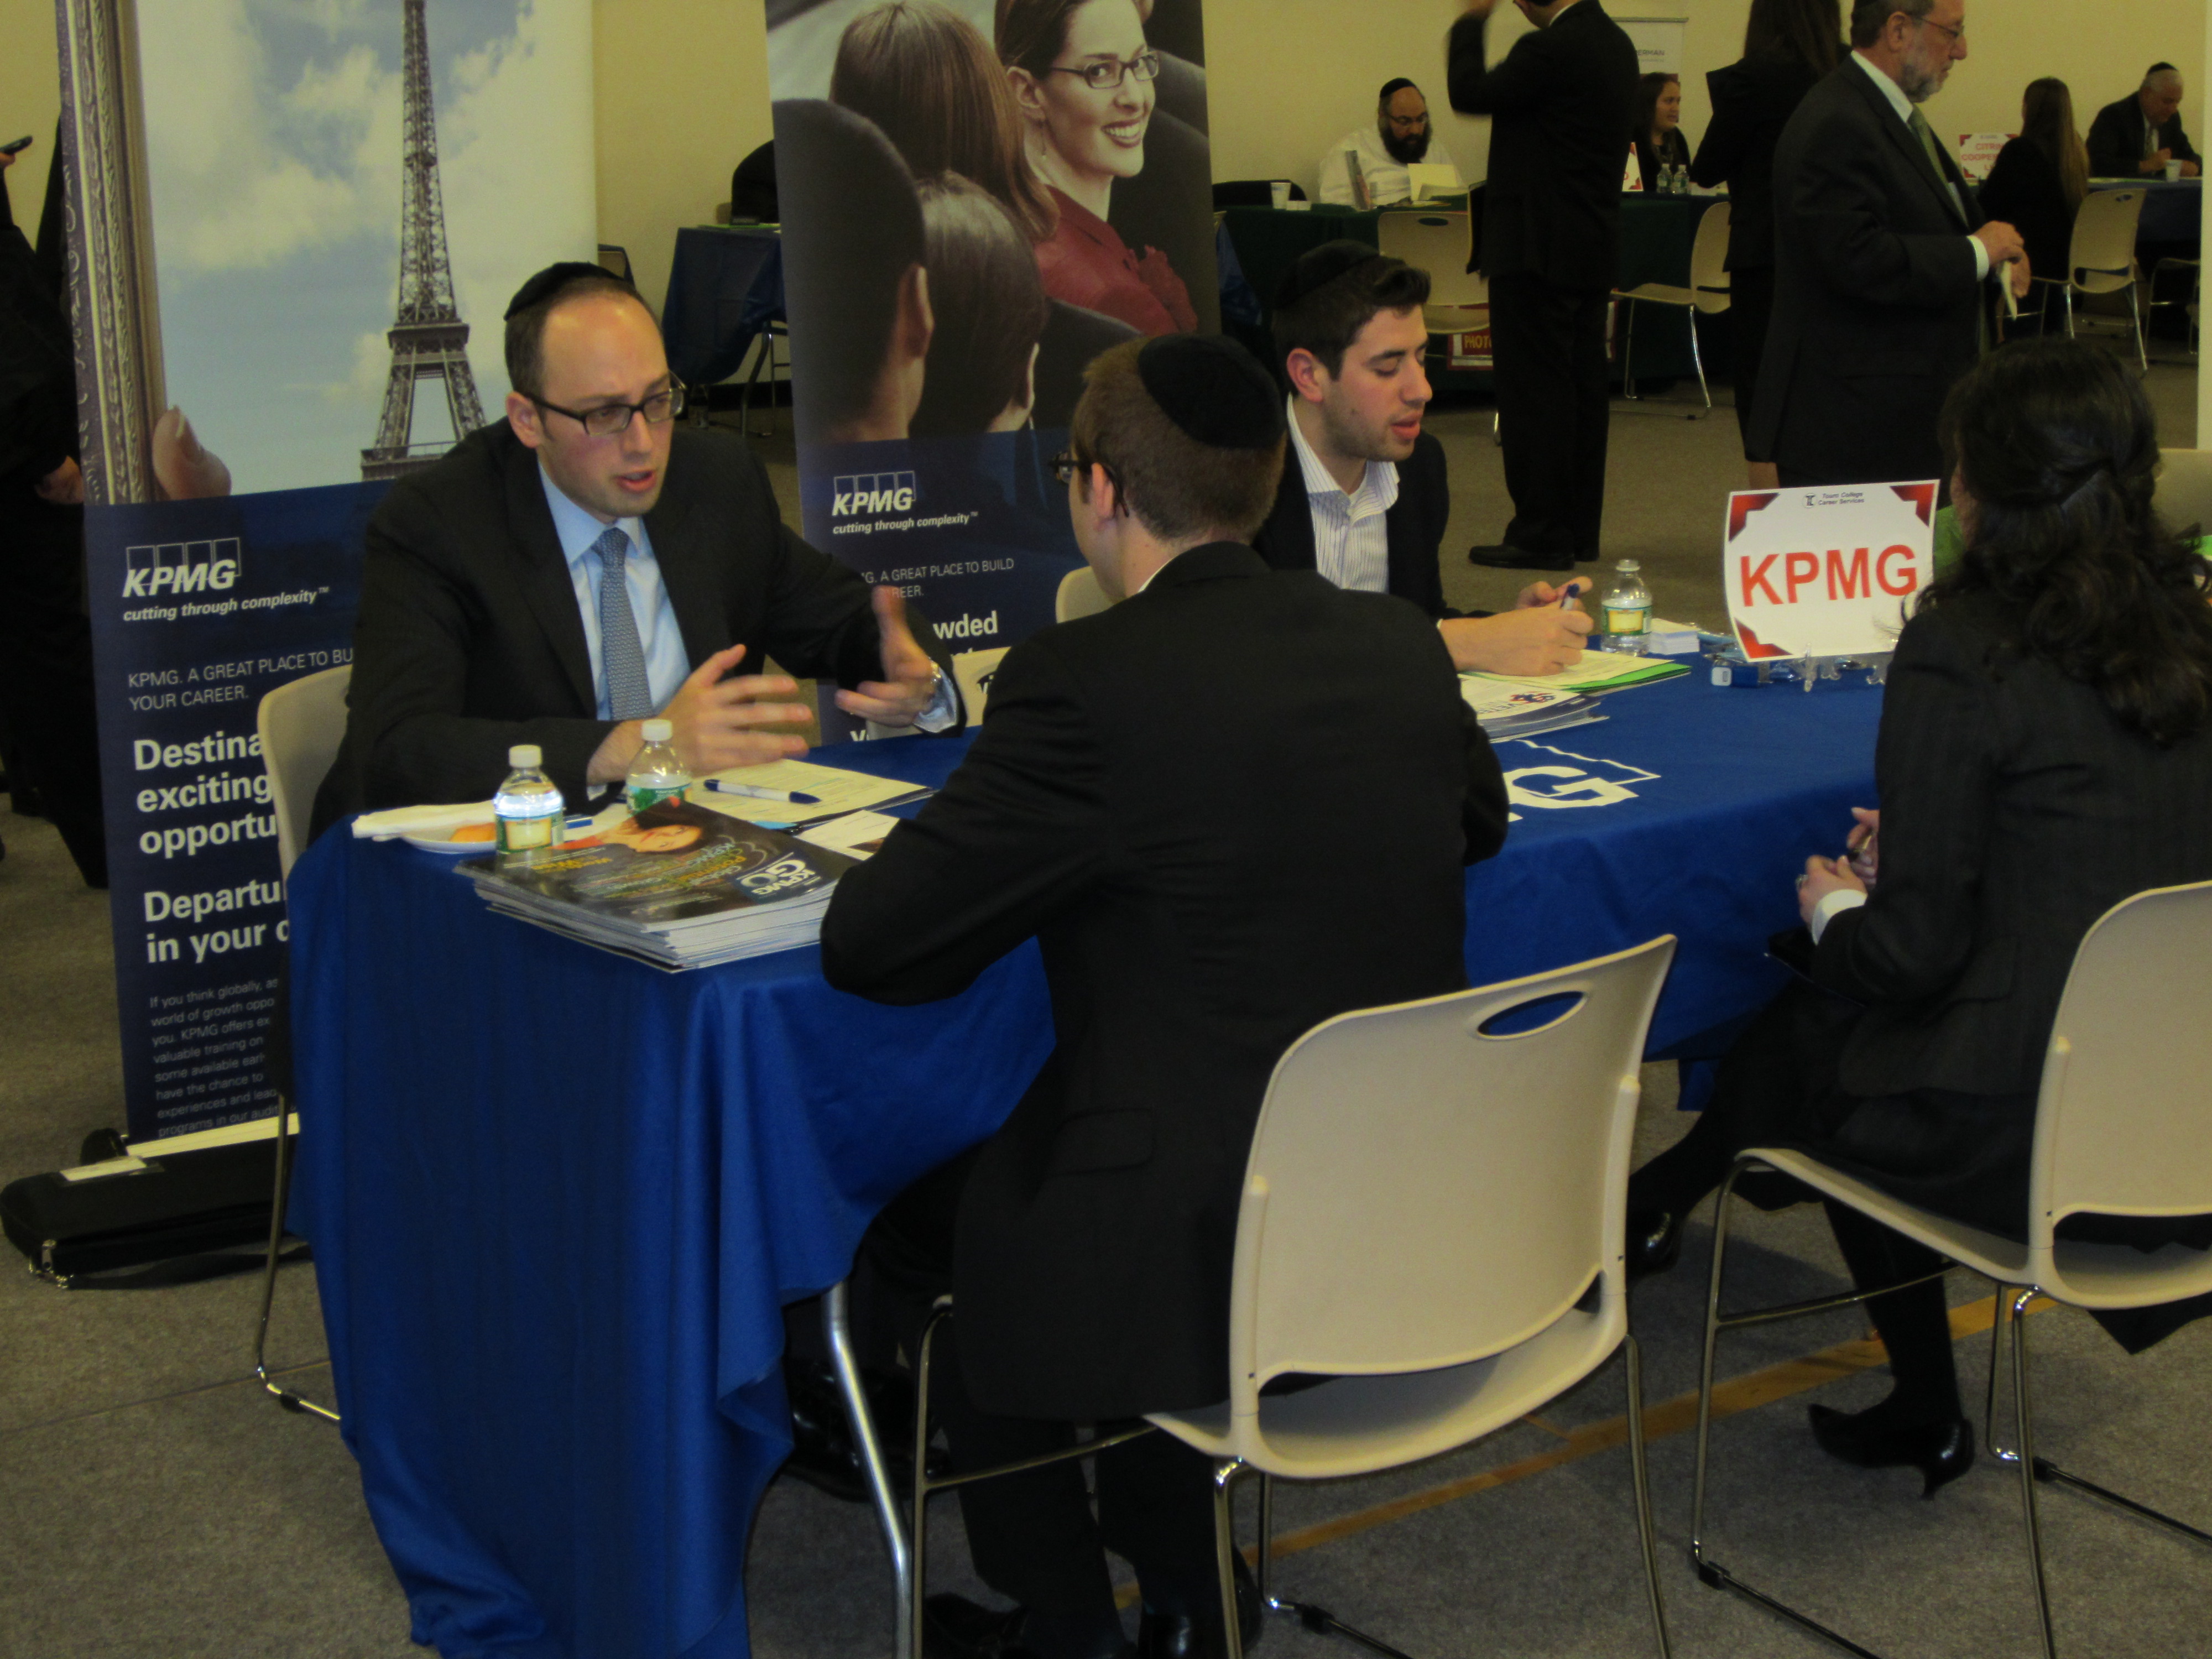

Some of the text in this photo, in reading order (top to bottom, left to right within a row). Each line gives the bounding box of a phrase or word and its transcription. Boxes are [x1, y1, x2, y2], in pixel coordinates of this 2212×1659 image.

[832, 487, 912, 516] KPMG
[833, 521, 873, 535] cutting
[874, 518, 915, 531] through
[122, 559, 237, 598] KPMG
[880, 570, 891, 582] A
[891, 566, 927, 581] GREAT
[930, 563, 964, 577] PLACE
[965, 561, 980, 573] TO
[982, 557, 1015, 572] BUILD
[1740, 544, 1917, 607] KPMG
[123, 606, 178, 621] cutting
[181, 598, 238, 617] through
[128, 670, 183, 688] KPMG.
[187, 668, 200, 682] A
[203, 660, 254, 681] GREAT
[258, 654, 307, 674] PLACE
[308, 651, 328, 666] TO
[128, 685, 249, 711] YOUR CAREER.
[133, 730, 262, 771] Destina
[137, 771, 273, 813] exciting
[139, 812, 276, 859] opportu
[740, 859, 806, 888] GO
[750, 869, 817, 895] KPMG
[147, 932, 180, 963] in
[189, 923, 267, 964] your
[150, 996, 159, 1008] If
[161, 996, 184, 1009] you
[186, 988, 215, 1003] think
[150, 1012, 185, 1026] world
[187, 1008, 200, 1021] of
[202, 1001, 243, 1021] growth
[181, 1023, 218, 1040] KPMG
[221, 1020, 254, 1034] offers
[153, 1036, 264, 1063] valuable training on
[155, 1068, 188, 1083] some
[191, 1058, 239, 1076] available
[156, 1073, 264, 1100] have the chance to
[157, 1098, 227, 1119] experiences
[230, 1092, 251, 1105] and
[159, 1118, 213, 1138] programs
[216, 1116, 227, 1126] in
[229, 1112, 249, 1123] our
